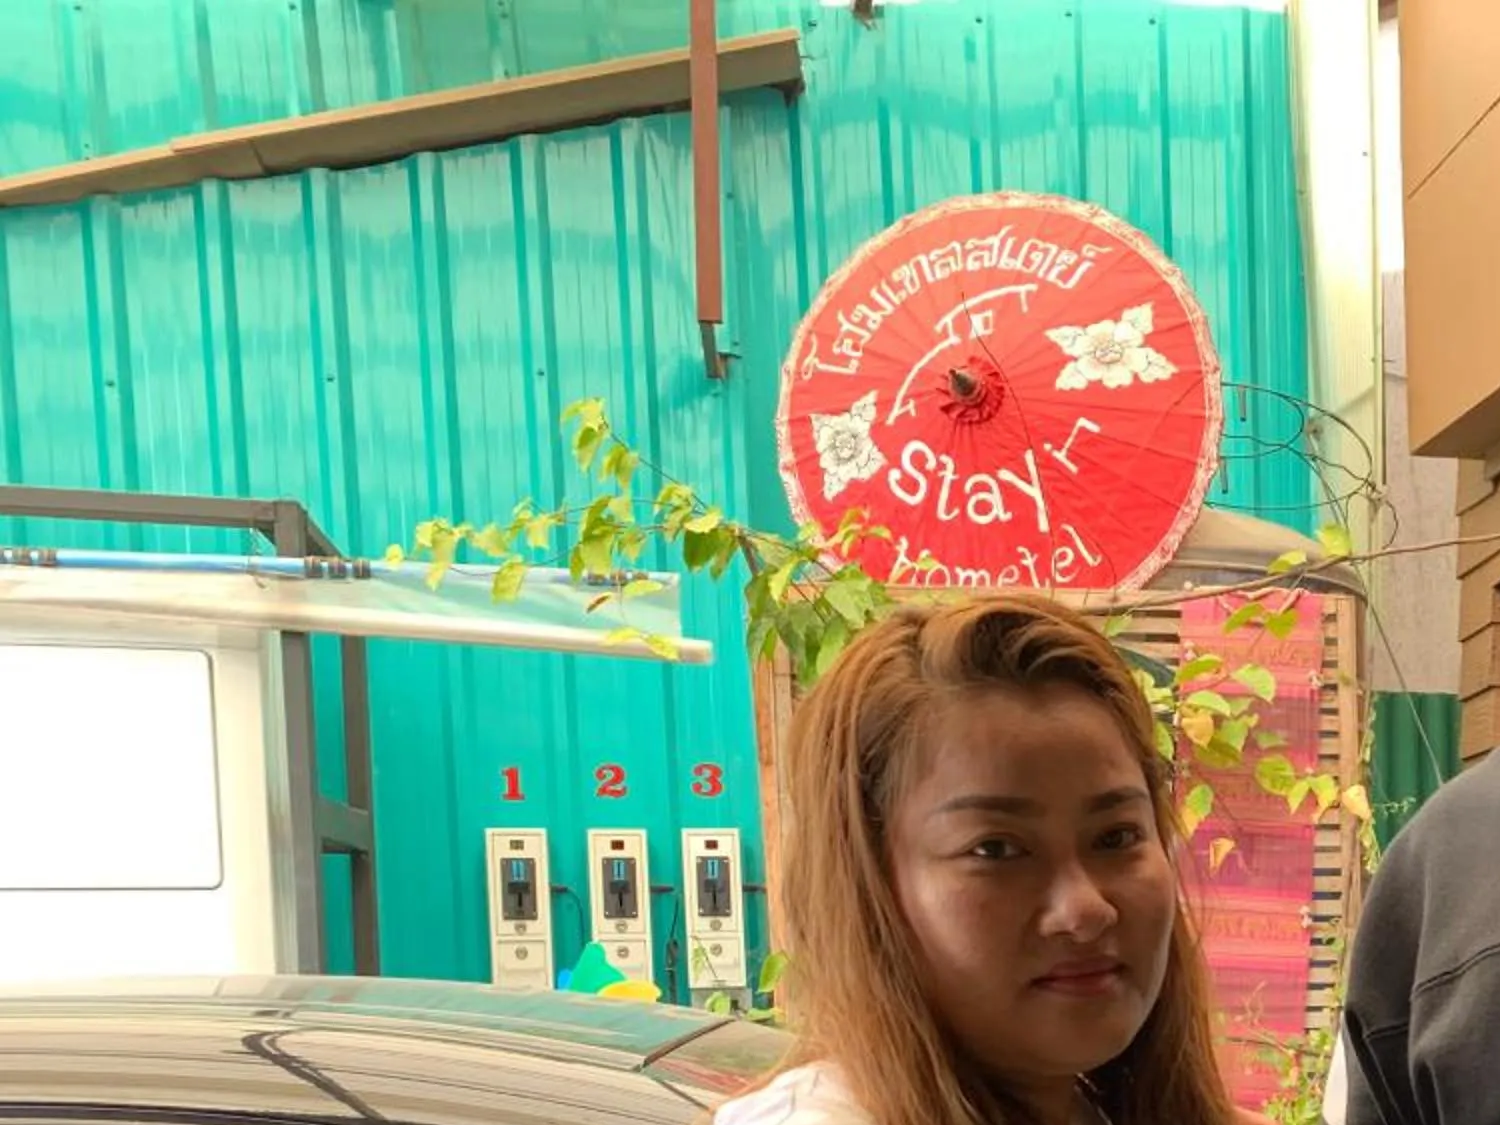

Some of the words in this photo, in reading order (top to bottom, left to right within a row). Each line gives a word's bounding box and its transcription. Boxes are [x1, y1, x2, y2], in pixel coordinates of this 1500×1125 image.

[888, 440, 1049, 533] Stay
[502, 766, 525, 801] 1
[595, 764, 627, 798] 2
[692, 763, 723, 797] 3
